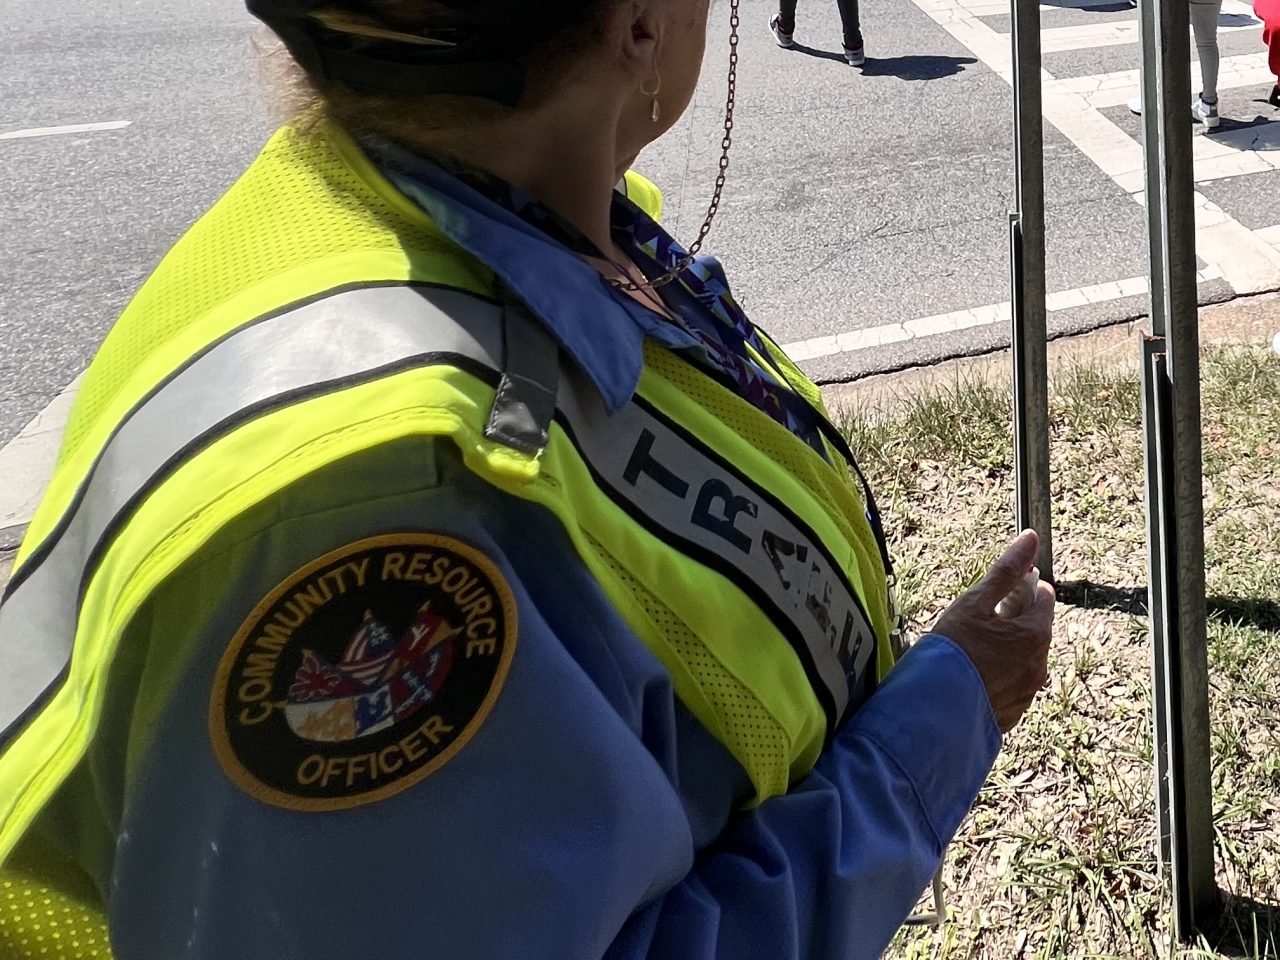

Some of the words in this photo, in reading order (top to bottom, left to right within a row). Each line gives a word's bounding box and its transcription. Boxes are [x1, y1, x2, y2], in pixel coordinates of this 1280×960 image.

[238, 558, 371, 727] COMMUNITY
[381, 551, 499, 660] RESOURCE
[296, 713, 455, 788] OFFICER
